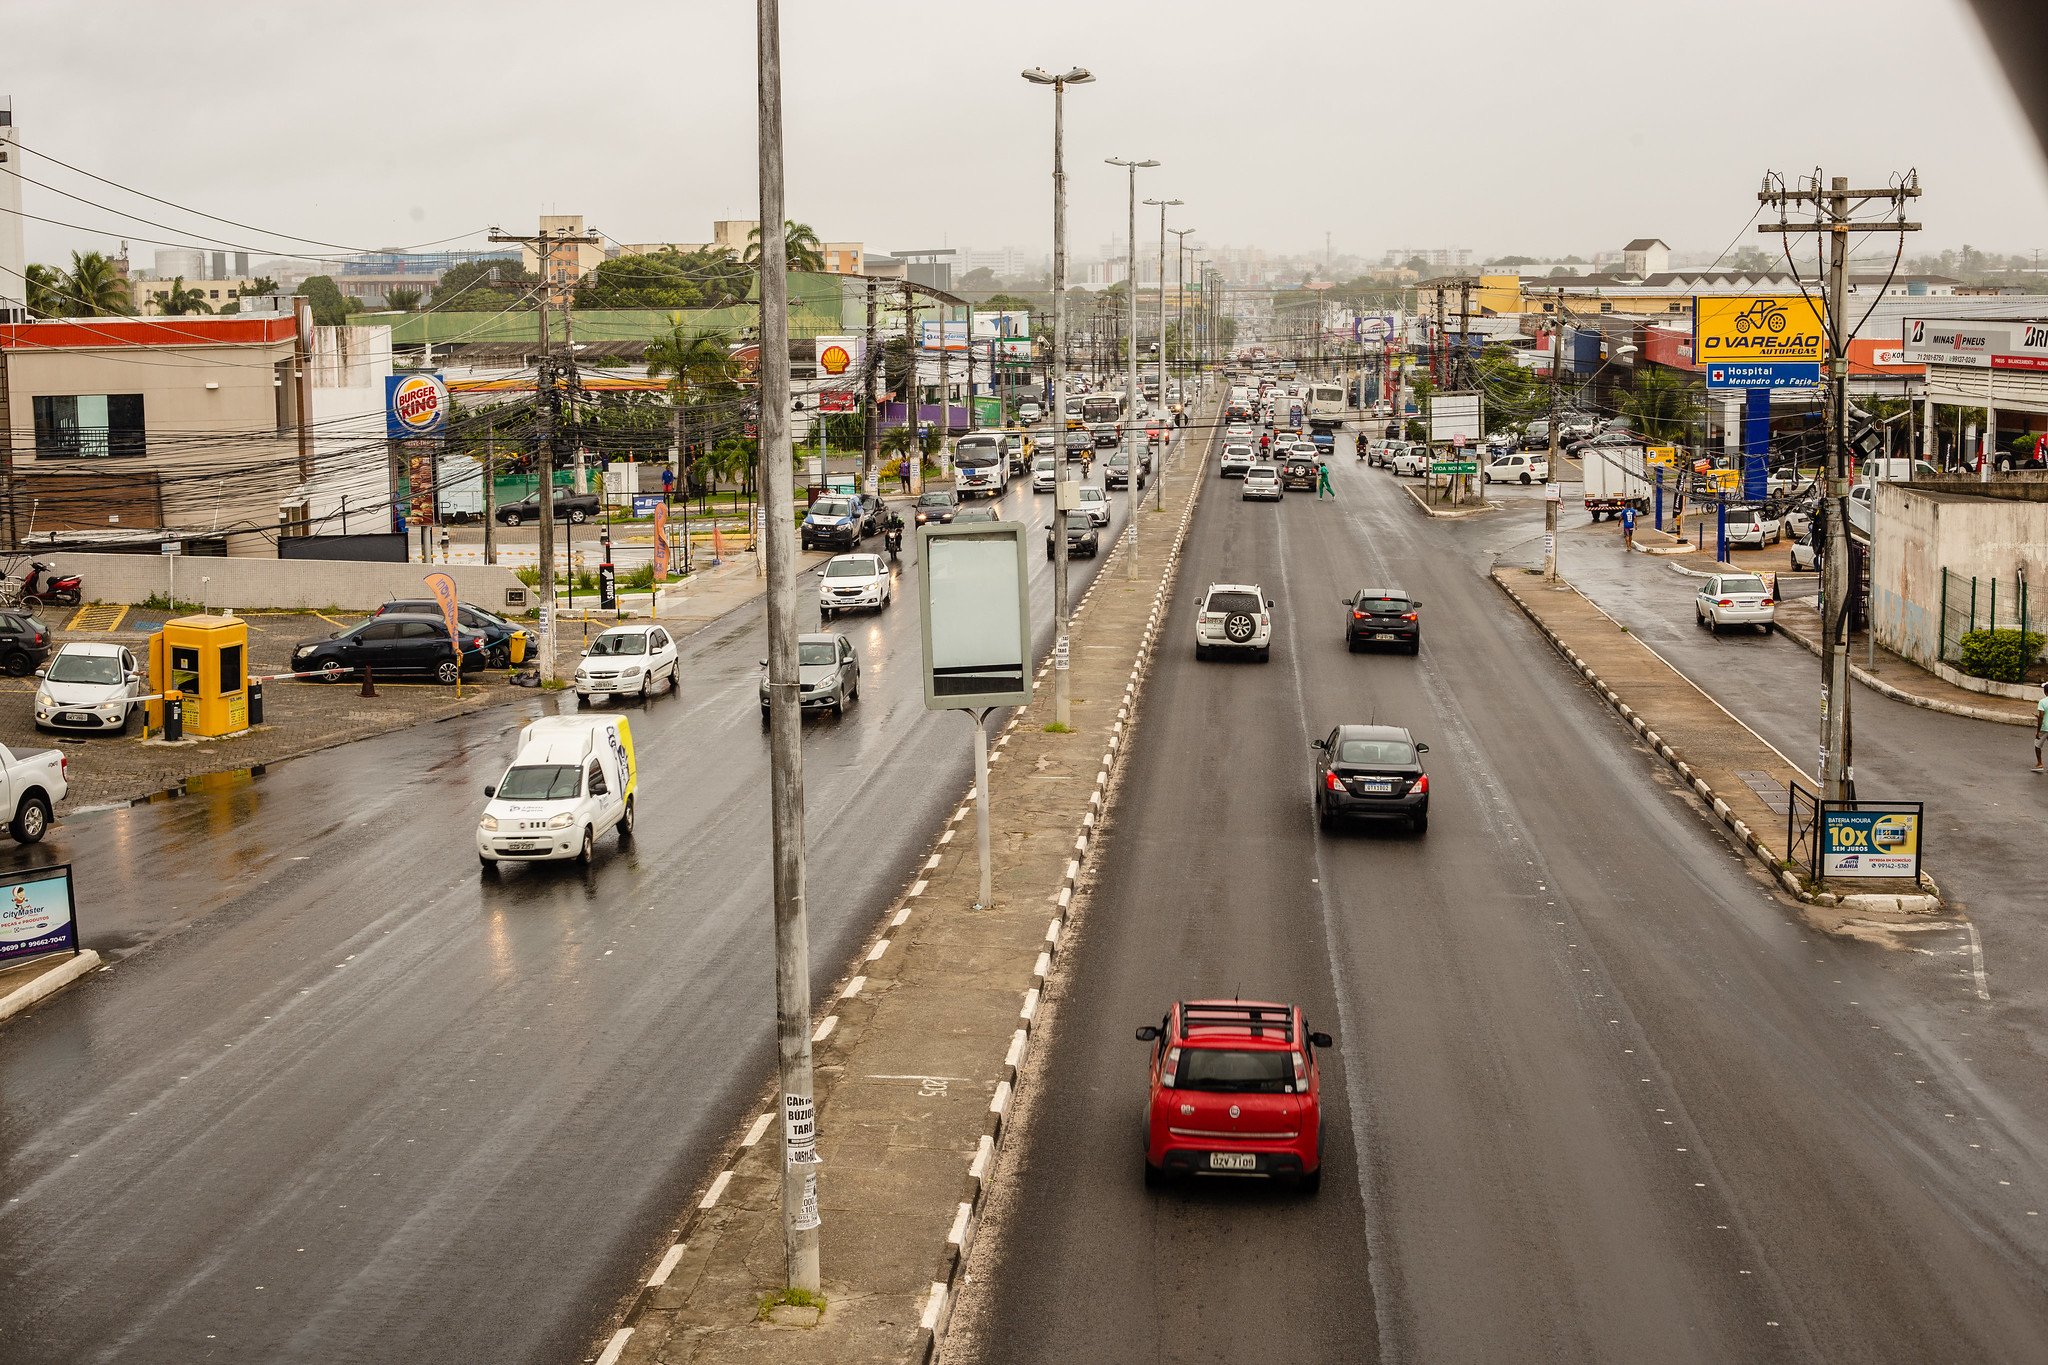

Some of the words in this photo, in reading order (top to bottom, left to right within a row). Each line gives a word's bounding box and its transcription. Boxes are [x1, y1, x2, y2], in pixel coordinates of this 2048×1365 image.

[1705, 337, 1721, 348] O
[1725, 332, 1820, 348] VAREJÃO
[1933, 335, 1954, 345] MINAS
[1961, 336, 1986, 346] PNEUS
[1728, 366, 1773, 376] Hospital
[1789, 378, 1812, 386] Faria
[399, 386, 435, 407] BURGER
[401, 395, 437, 420] KING
[1829, 826, 1868, 847] 10x
[3, 906, 45, 919] CityMaster
[22, 915, 50, 924] PRODUTOS
[1212, 1157, 1229, 1168] OZV
[1232, 1157, 1254, 1168] 7109
